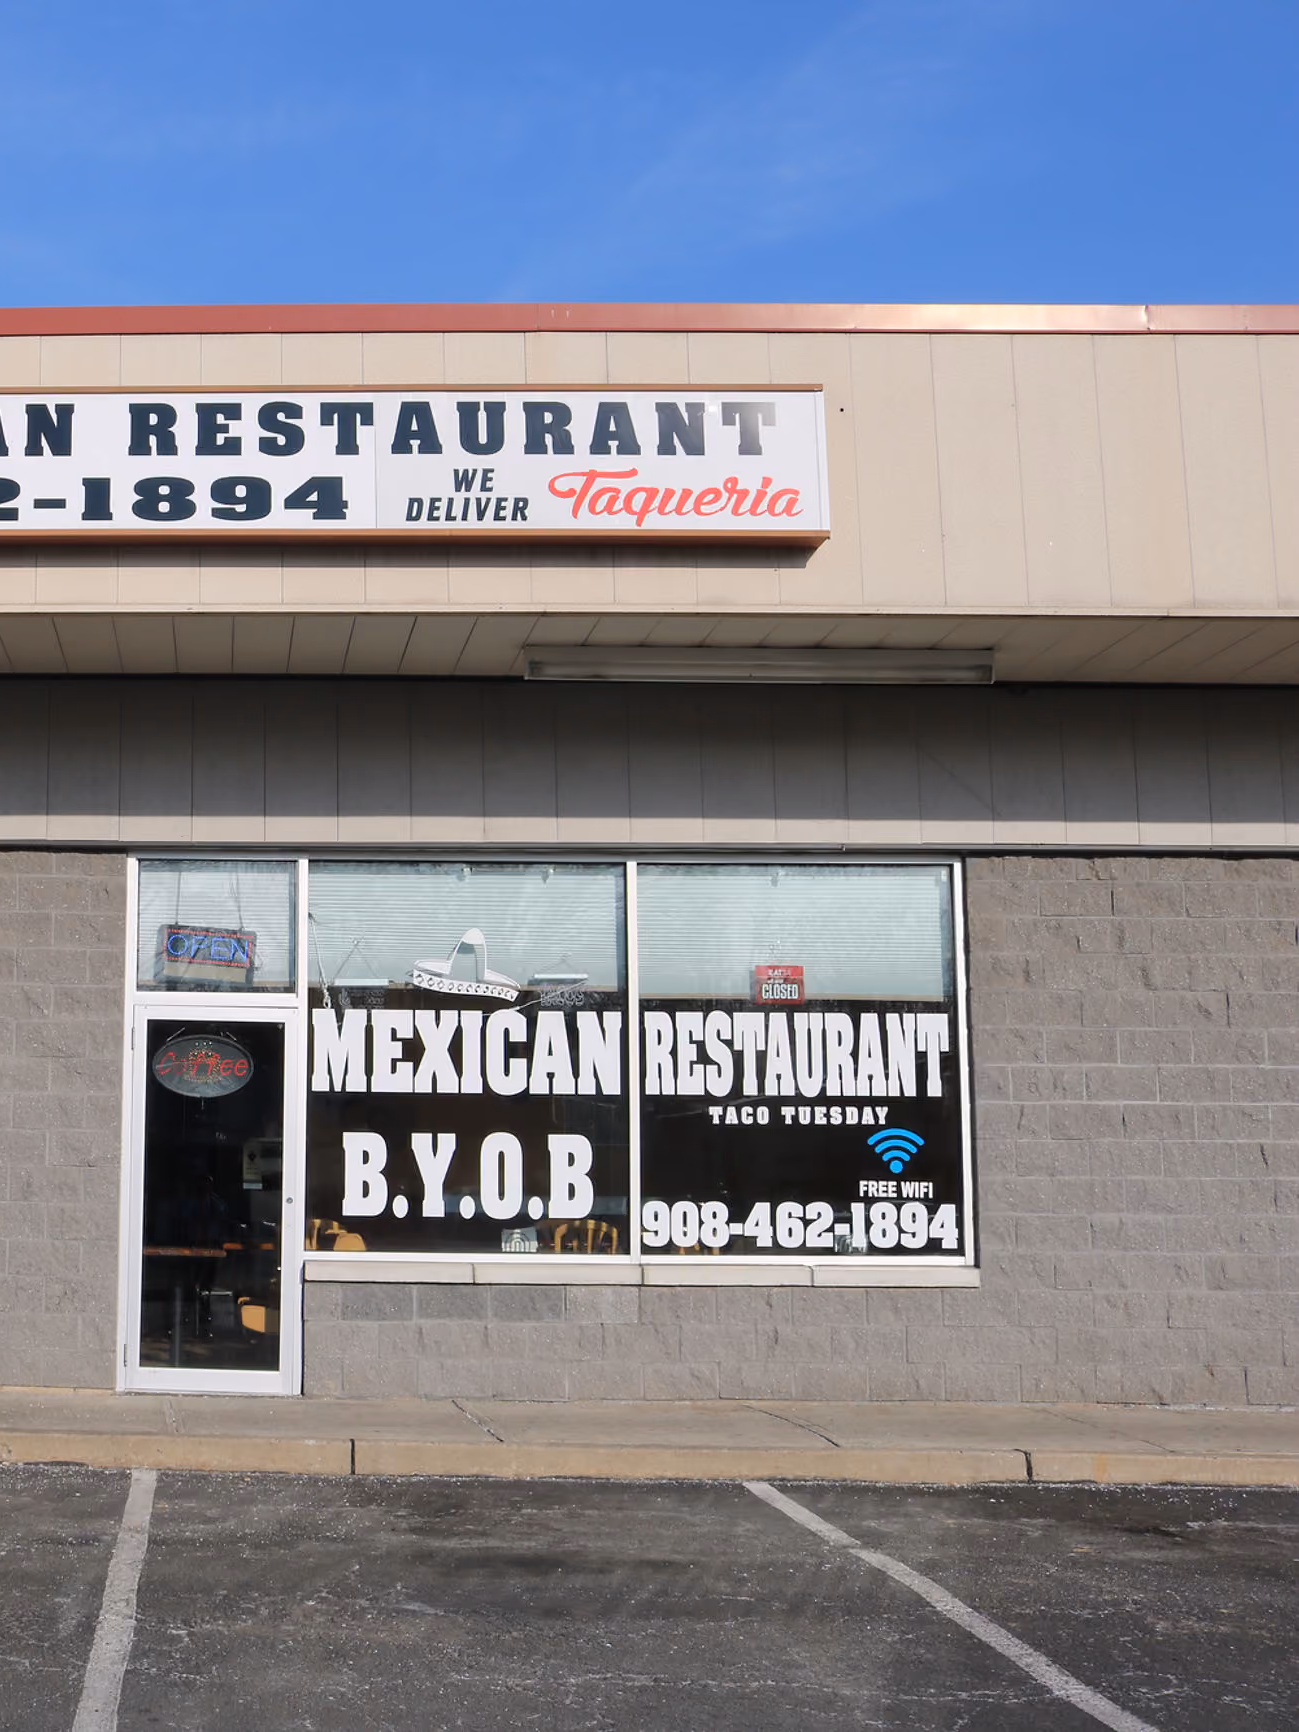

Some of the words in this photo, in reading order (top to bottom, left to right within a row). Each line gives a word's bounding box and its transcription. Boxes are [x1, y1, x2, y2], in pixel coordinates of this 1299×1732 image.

[128, 400, 777, 457] RESTAURANT
[453, 467, 497, 493] WE
[406, 496, 529, 523] DELIVER
[547, 466, 805, 527] Taqueria
[167, 934, 249, 962] OPEN
[762, 983, 799, 999] CLOSED
[311, 1009, 622, 1096] MEXICAN
[644, 1010, 950, 1097] RESTAURANT
[708, 1106, 769, 1125] TACO
[781, 1106, 889, 1126] TUESDAY
[342, 1131, 594, 1220] B.Y.O.B
[859, 1180, 897, 1198] FREE
[901, 1182, 934, 1199] WIFI
[641, 1201, 959, 1249] 908-462-1894
